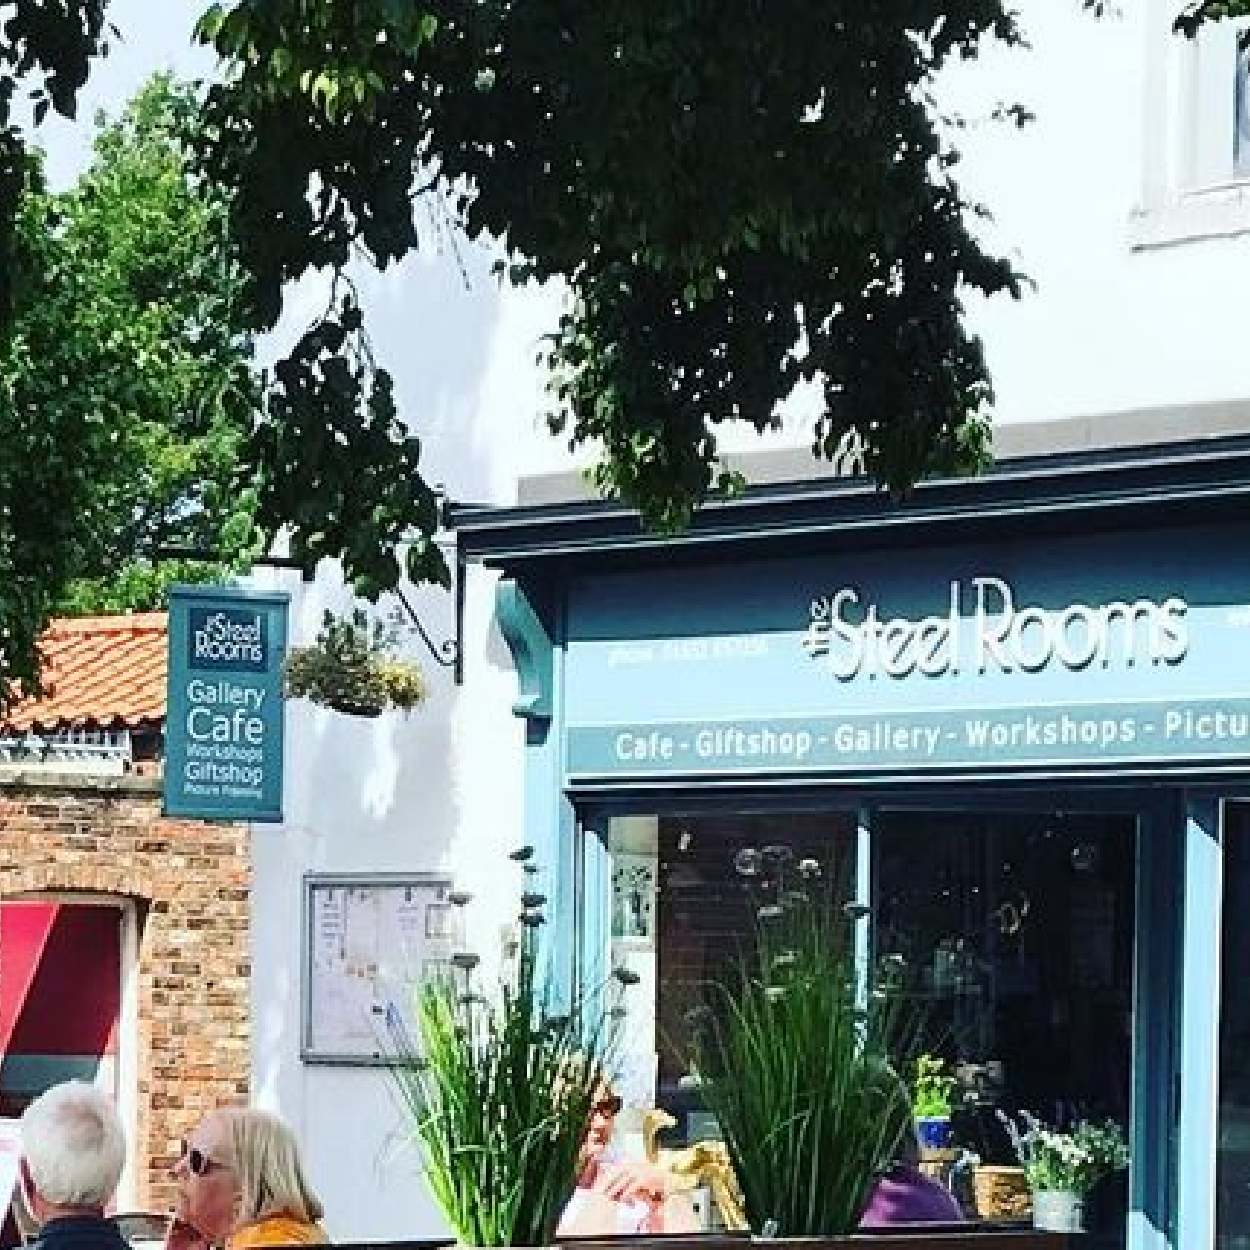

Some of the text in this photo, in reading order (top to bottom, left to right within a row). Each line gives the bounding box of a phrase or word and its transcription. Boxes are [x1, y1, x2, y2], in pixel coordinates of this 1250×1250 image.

[195, 630, 263, 662] Rooms
[803, 577, 1190, 682] the Steel Rooms
[188, 681, 265, 709] Gallery
[187, 708, 263, 743] Cafe
[616, 733, 673, 760] Cafe
[696, 729, 811, 759] Giftshop
[835, 721, 940, 756] Gallery
[966, 715, 1137, 749] Workshops
[1165, 710, 1250, 739] Pictu
[184, 761, 263, 786] Giftshop
